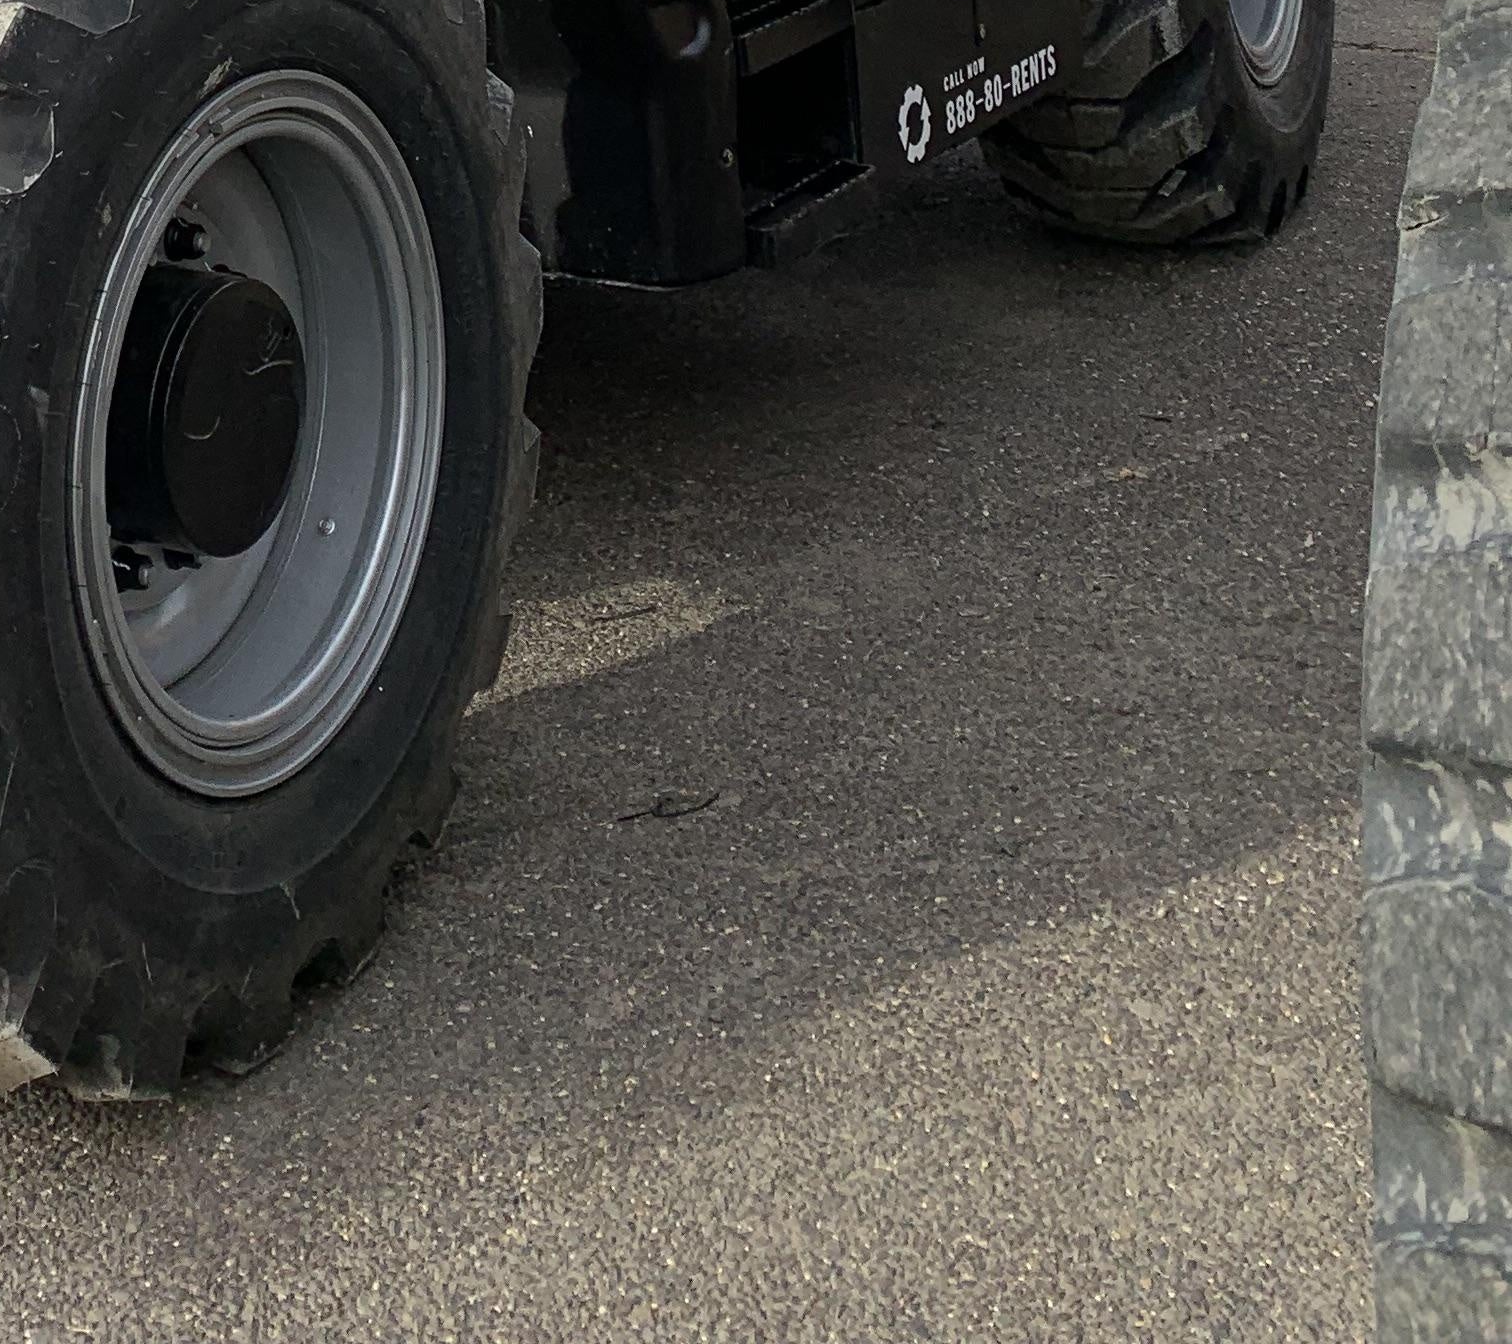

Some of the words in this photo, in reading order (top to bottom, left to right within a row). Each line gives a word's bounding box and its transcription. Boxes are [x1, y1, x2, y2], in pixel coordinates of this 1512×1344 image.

[943, 68, 965, 92] CALL
[967, 56, 985, 80] NOW
[946, 44, 1057, 135] 888-80-RENTS
